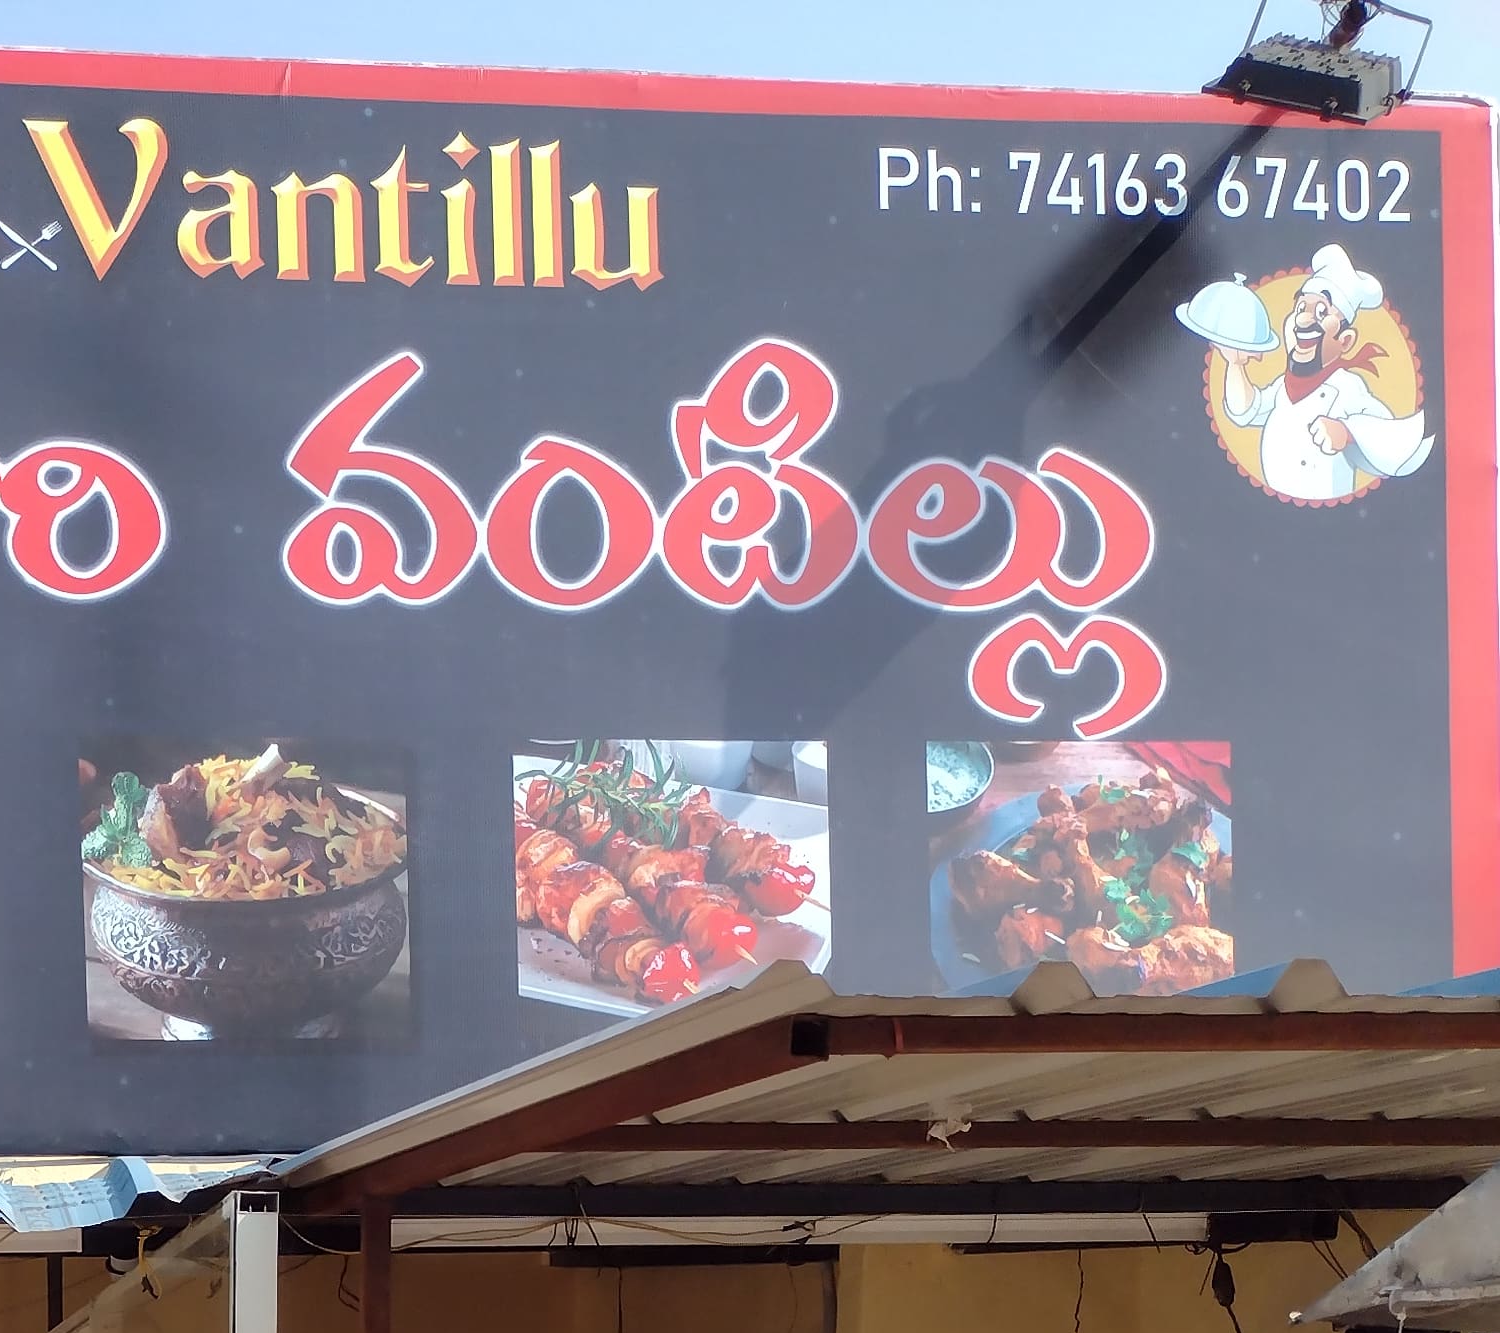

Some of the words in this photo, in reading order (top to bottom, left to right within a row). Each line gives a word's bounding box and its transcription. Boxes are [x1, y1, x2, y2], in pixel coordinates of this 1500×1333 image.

[22, 116, 666, 292] Vantillu
[876, 146, 982, 213] Ph:
[1008, 151, 1189, 217] 74163
[1215, 155, 1412, 223] 67402
[281, 337, 1168, 740] వంటిల్లు
